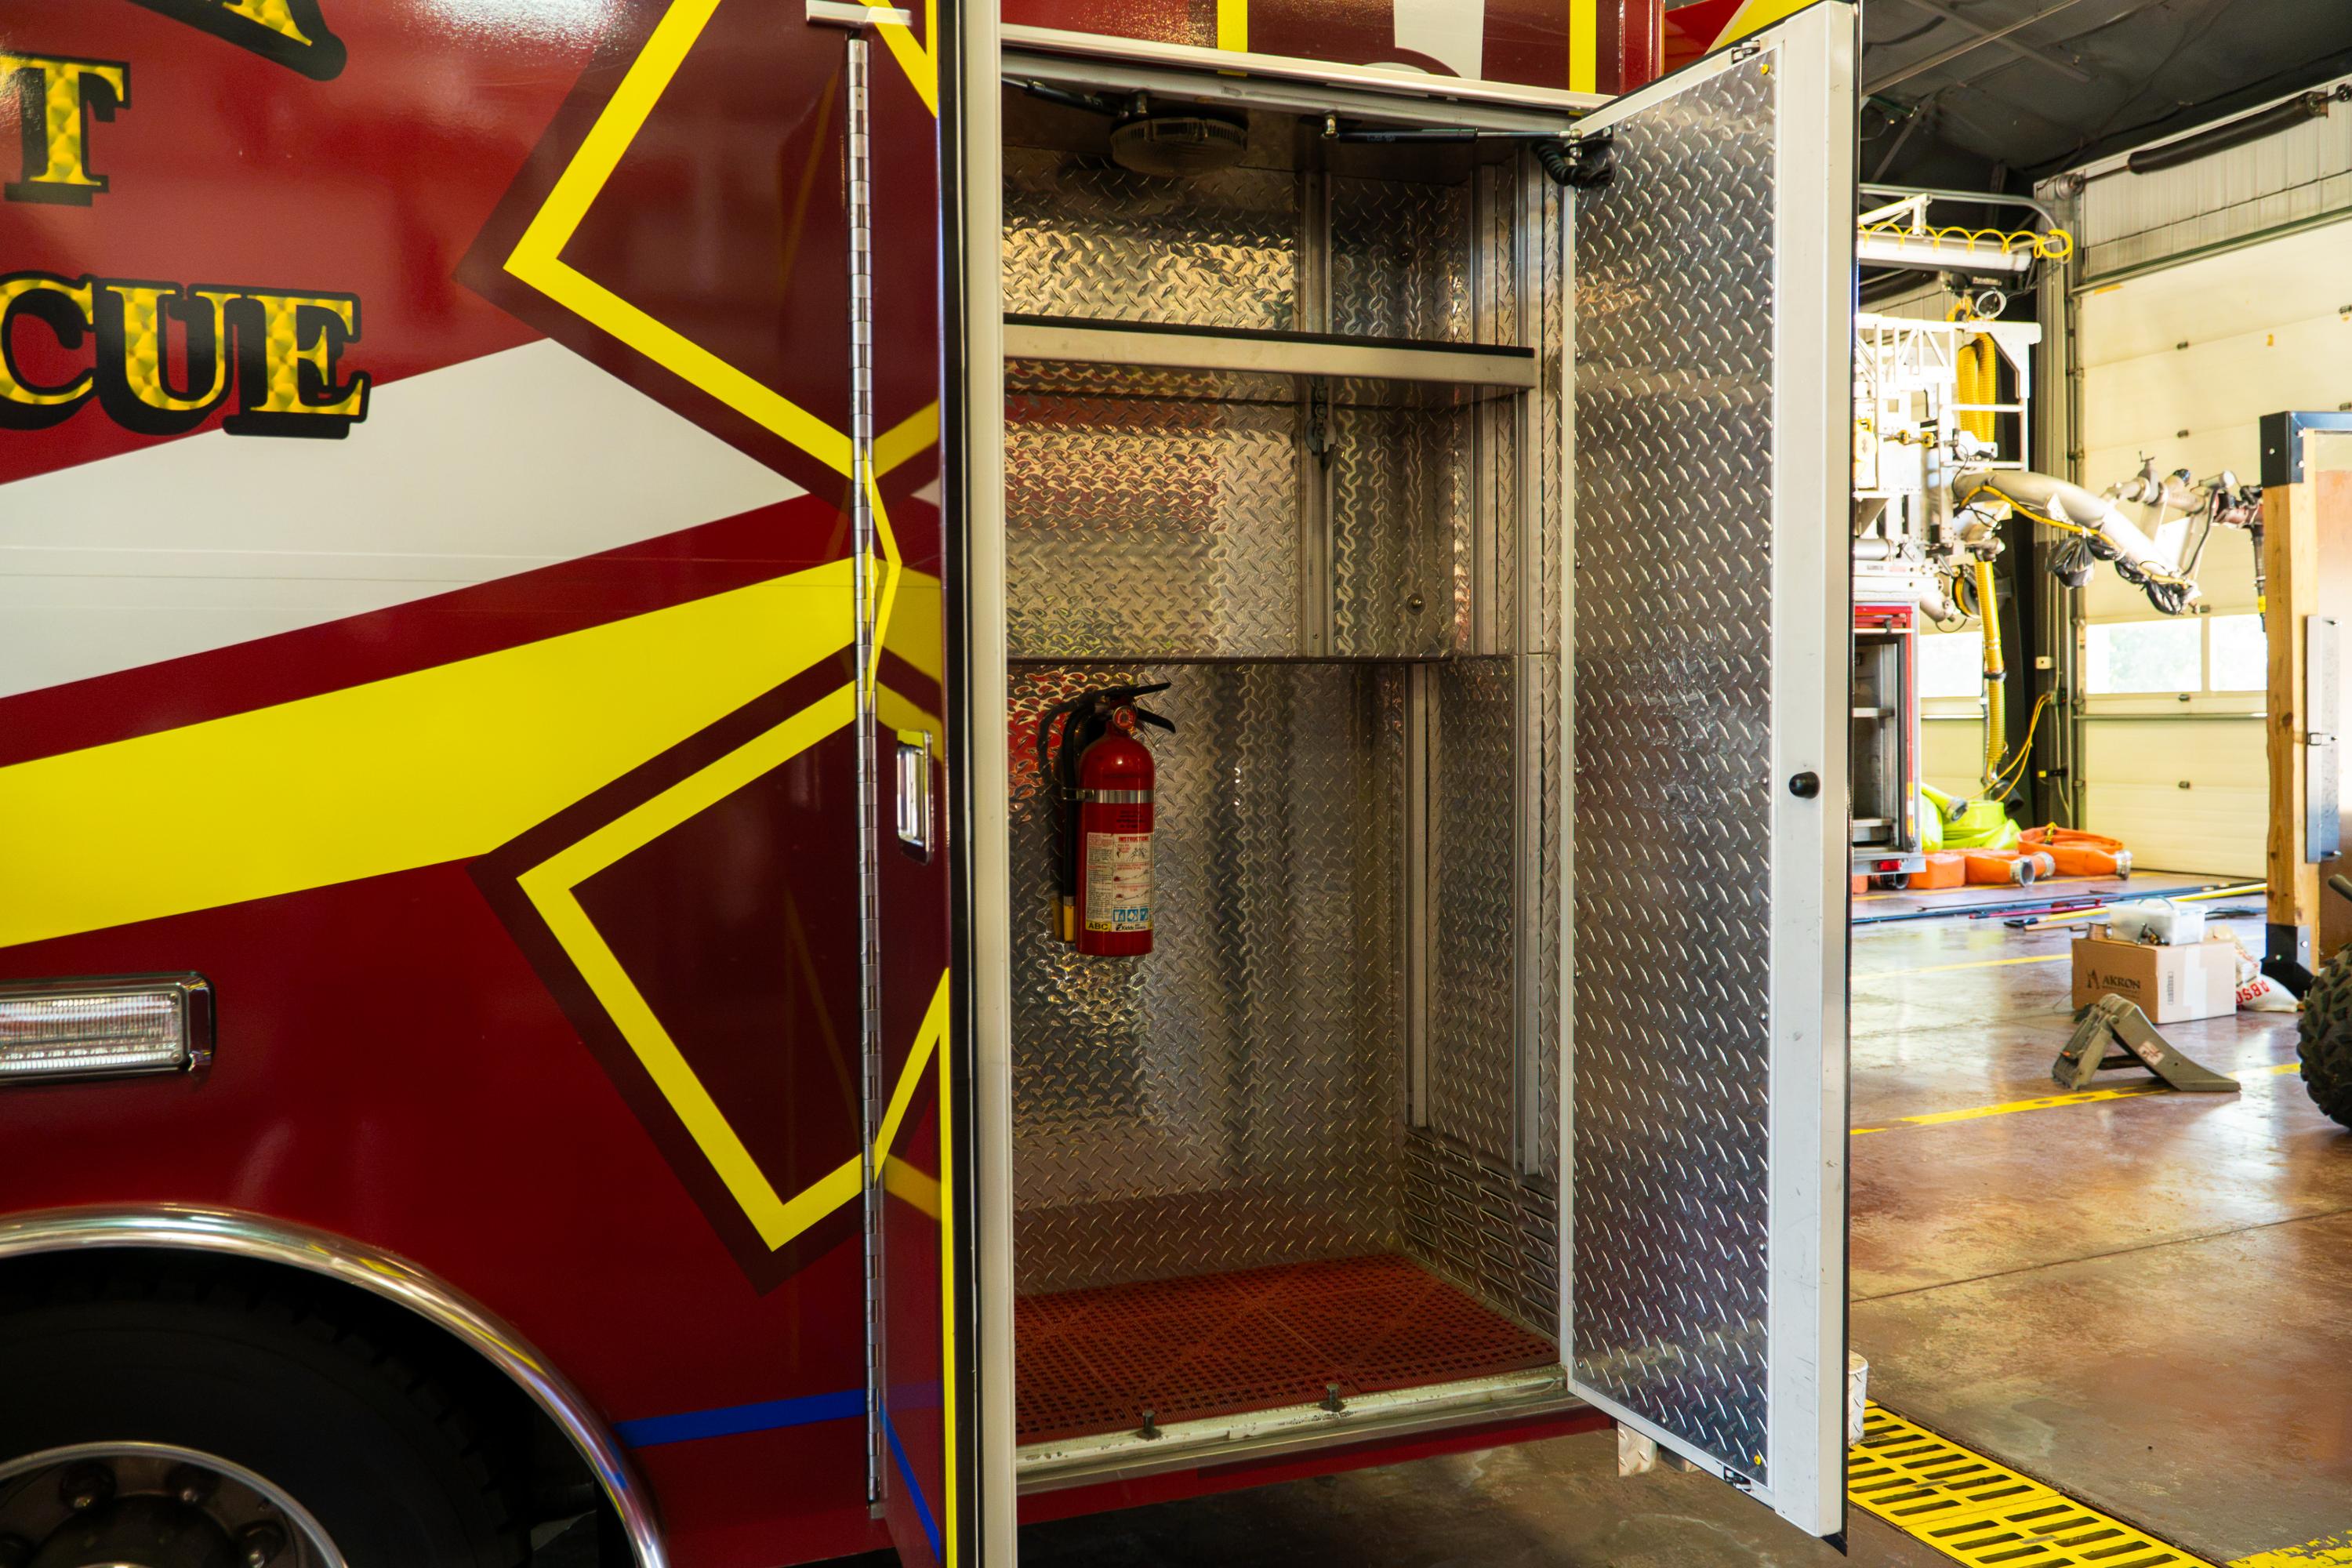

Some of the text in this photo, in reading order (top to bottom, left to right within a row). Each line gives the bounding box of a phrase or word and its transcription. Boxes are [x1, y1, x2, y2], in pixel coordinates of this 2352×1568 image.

[0, 271, 370, 439] CUE
[1088, 922, 1109, 931] ABC
[2103, 975, 2141, 989] AKRON
